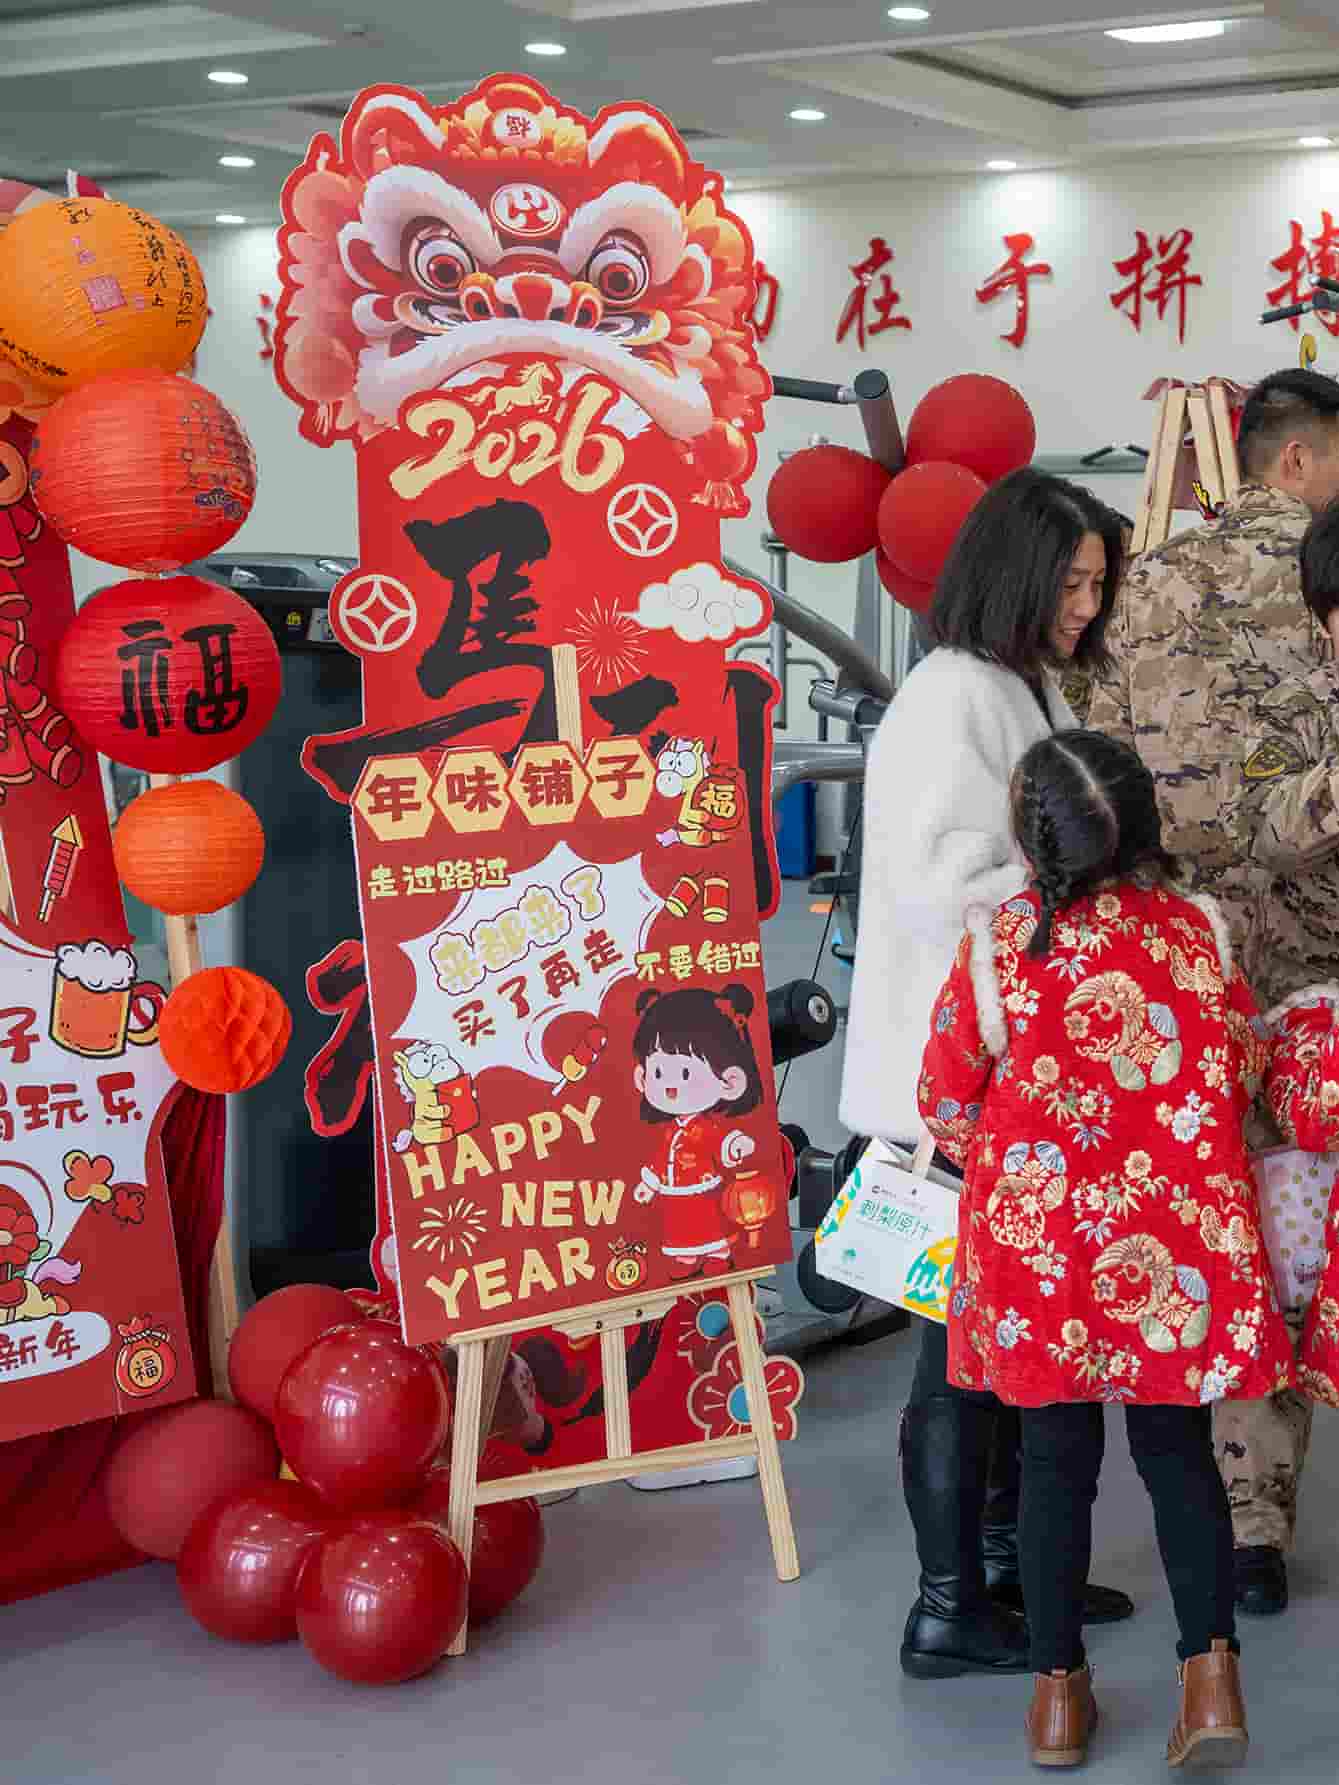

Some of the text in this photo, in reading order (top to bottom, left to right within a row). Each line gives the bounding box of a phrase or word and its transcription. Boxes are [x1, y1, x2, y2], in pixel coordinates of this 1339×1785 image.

[388, 379, 626, 499] 2026
[116, 619, 250, 738] 福
[365, 754, 646, 823] 年味铺子
[700, 782, 738, 819] 福
[367, 857, 512, 900] 走过路过
[452, 929, 624, 1047] 买了再走
[635, 940, 761, 982] 不要错过
[402, 1096, 601, 1199] HAPPY
[501, 1179, 625, 1229] NEW
[425, 1237, 596, 1321] YEAR
[0, 1320, 80, 1372] 新年
[135, 1355, 158, 1382] 福
